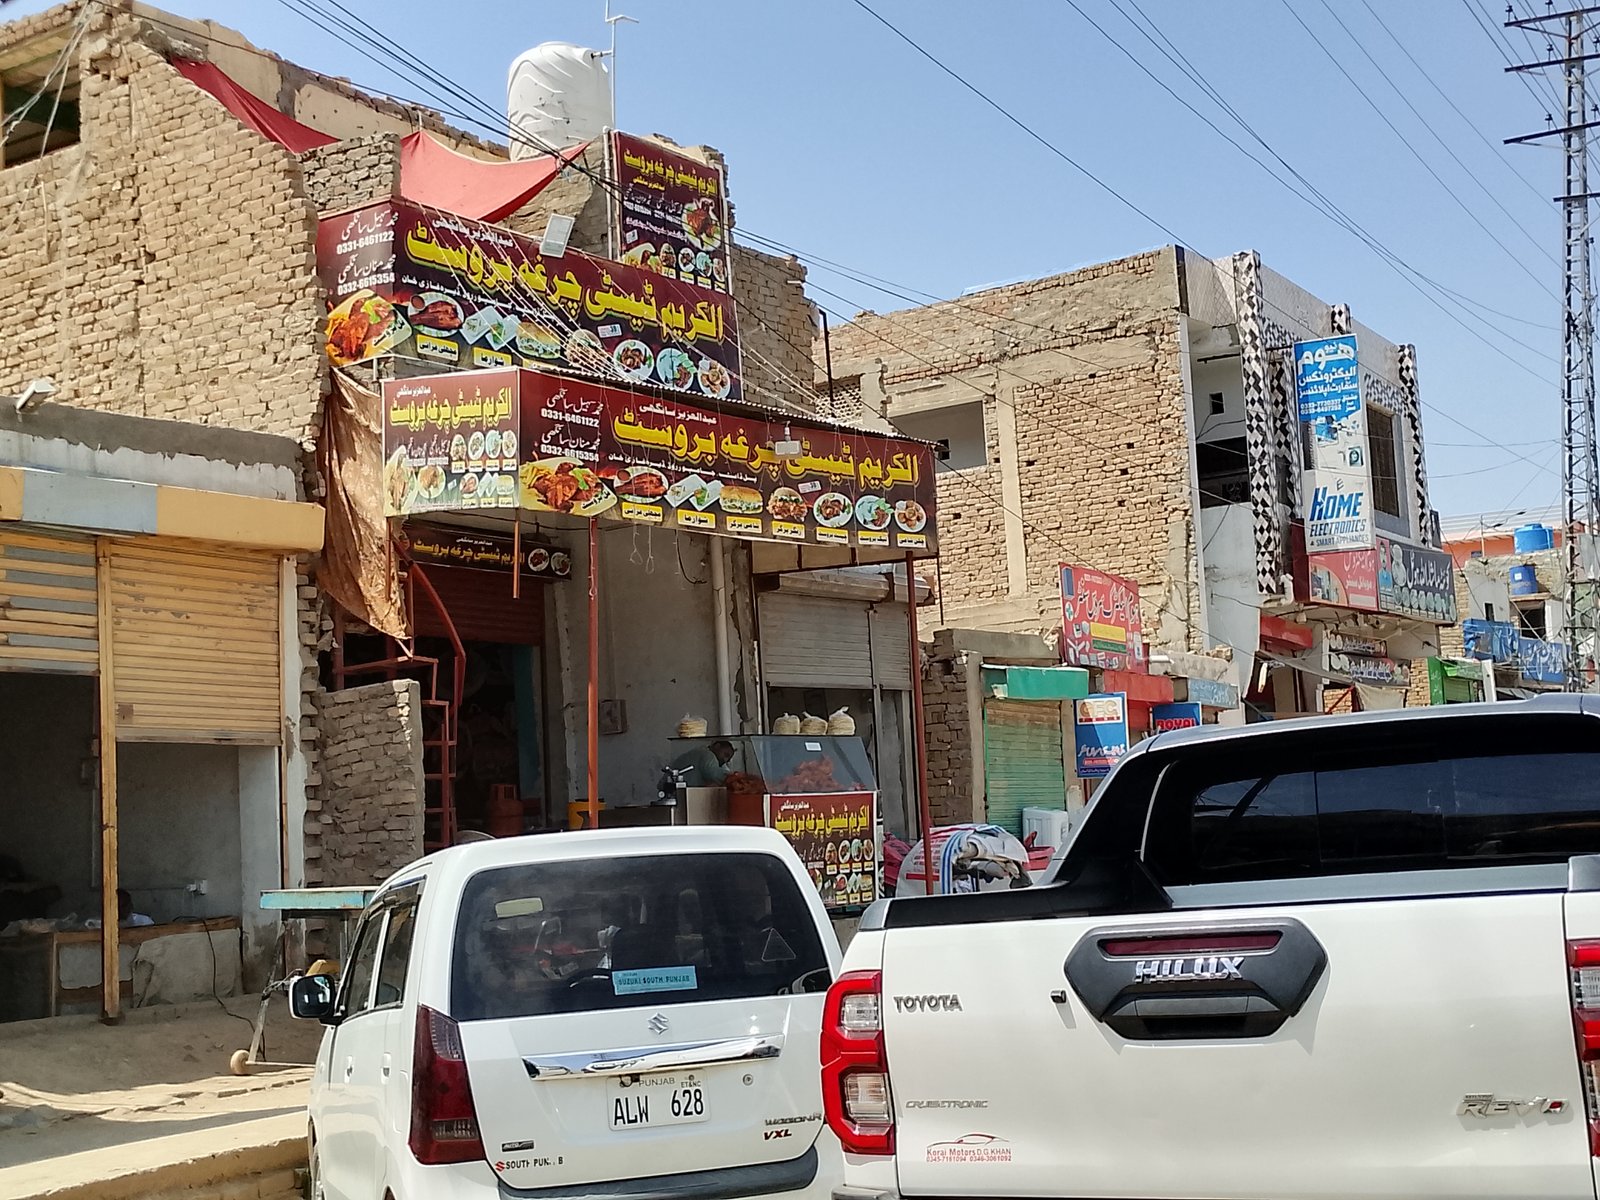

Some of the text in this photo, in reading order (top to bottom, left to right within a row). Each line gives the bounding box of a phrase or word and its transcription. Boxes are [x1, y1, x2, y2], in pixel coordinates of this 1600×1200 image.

[336, 231, 395, 255] 0331-6461122
[406, 220, 514, 292] بروسٹ
[337, 272, 396, 297] 0332-6615354
[518, 253, 583, 317] چرغہ
[586, 268, 657, 328] ٹیسٹی
[661, 300, 724, 341] الکریم
[390, 385, 512, 434] الکریم ٹیسٹی چرغہ بروسٹ
[540, 408, 600, 428] 0331-6461122
[676, 410, 718, 425] عبدالعزیز
[540, 443, 600, 462] 0332-6615354
[613, 407, 920, 489] الکریم ٹیسٹی چرغہ بروسٹ
[1309, 486, 1364, 521] HOME
[1310, 518, 1367, 538] ELECTRONICS
[413, 538, 450, 558] بروسٹ
[1316, 537, 1335, 547] SMART
[1080, 700, 1118, 717] GEC
[775, 809, 805, 840] بروسٹ
[826, 802, 849, 838] ٹیسٹی
[848, 804, 870, 839] الکریم
[618, 974, 690, 986] SUZUKI SOUTH PUNJAB
[1134, 957, 1244, 983] HILUX
[893, 994, 963, 1013] TOYOTA
[638, 1076, 675, 1088] PUNJAB
[613, 1088, 705, 1126] ALW 628
[905, 1100, 988, 1109] CRUISETRONIC
[763, 1128, 792, 1140] VXL
[533, 1156, 564, 1167] PUNB
[926, 1148, 947, 1156] Korai
[949, 1148, 976, 1156] Motors
